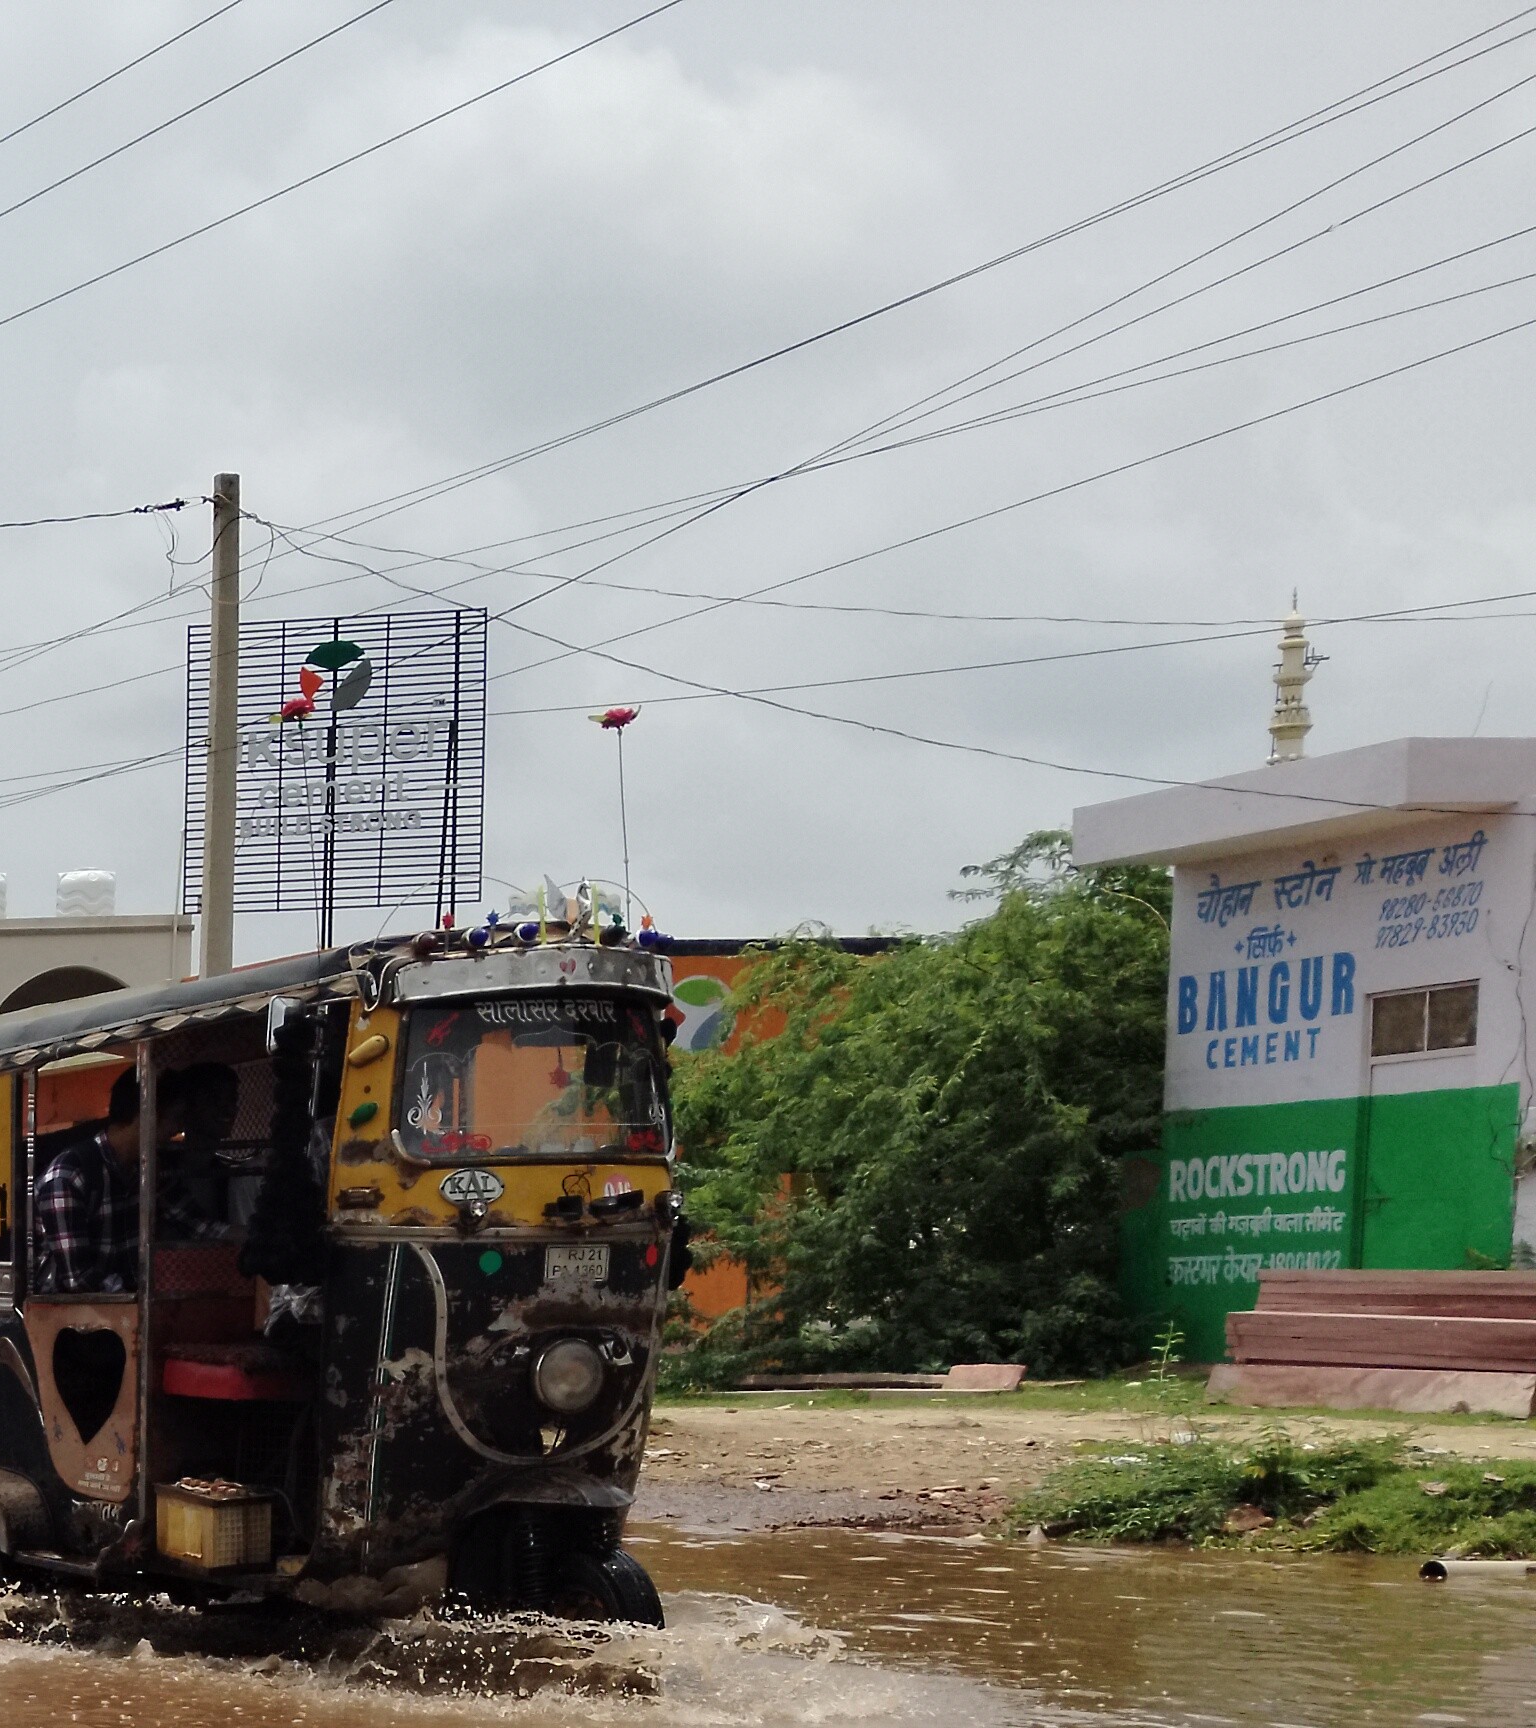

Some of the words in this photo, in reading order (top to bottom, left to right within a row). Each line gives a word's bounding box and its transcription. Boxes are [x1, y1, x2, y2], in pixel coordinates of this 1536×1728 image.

[258, 769, 410, 809] cement
[239, 817, 311, 838] BUILD
[319, 810, 422, 835] STRONG
[1439, 830, 1489, 877] अली
[1274, 860, 1342, 910] स्टोन
[1375, 908, 1480, 949] 97829-83930
[475, 1000, 561, 1023] सालासर
[564, 1000, 617, 1023] दरबार
[1178, 952, 1356, 1035] BANGUR
[1206, 1027, 1321, 1070] CEMENT
[450, 1169, 496, 1200] KAL
[1169, 1150, 1346, 1202] ROCKSTRONG
[568, 1250, 585, 1260] RJ
[588, 1249, 602, 1260] 21
